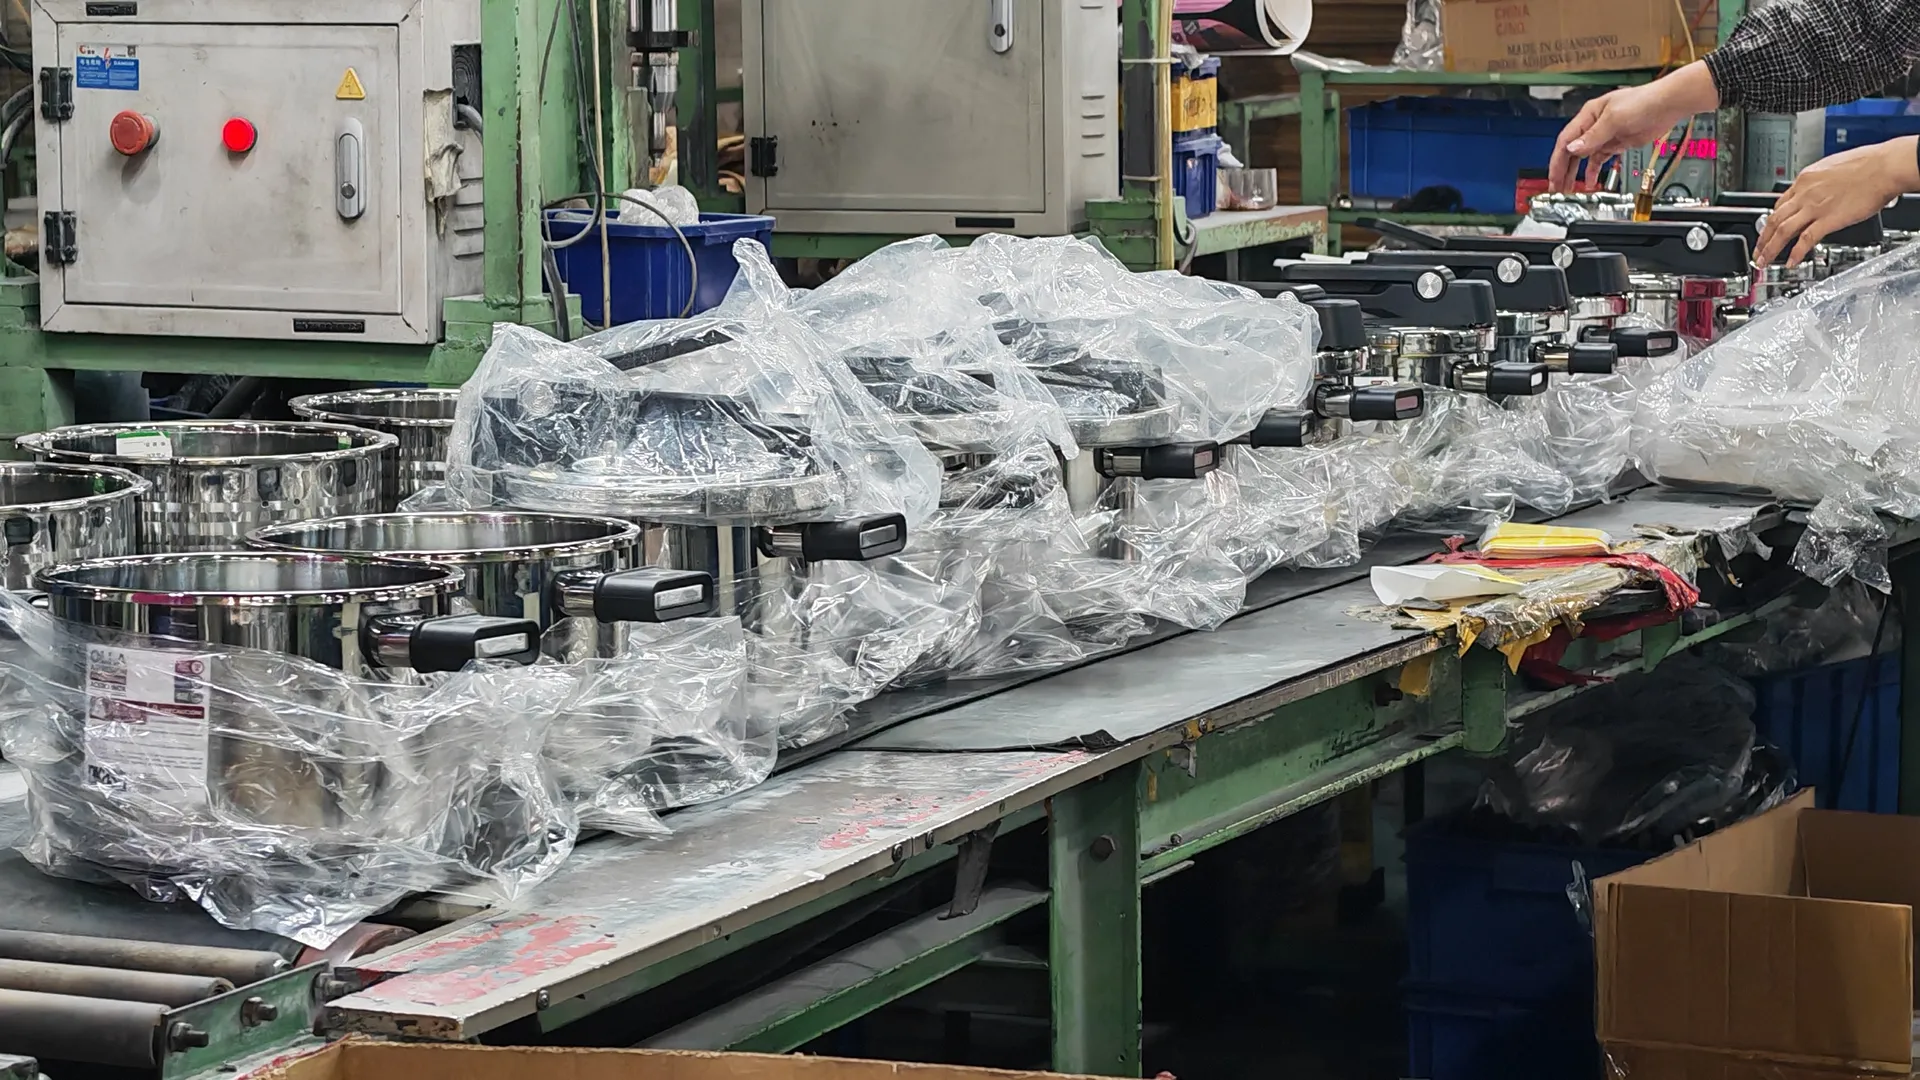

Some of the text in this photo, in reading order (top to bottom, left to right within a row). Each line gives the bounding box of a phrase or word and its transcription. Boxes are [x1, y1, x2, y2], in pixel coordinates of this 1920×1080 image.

[1494, 4, 1530, 20] CHINA
[1507, 43, 1535, 56] MADE
[1540, 41, 1551, 52] IN
